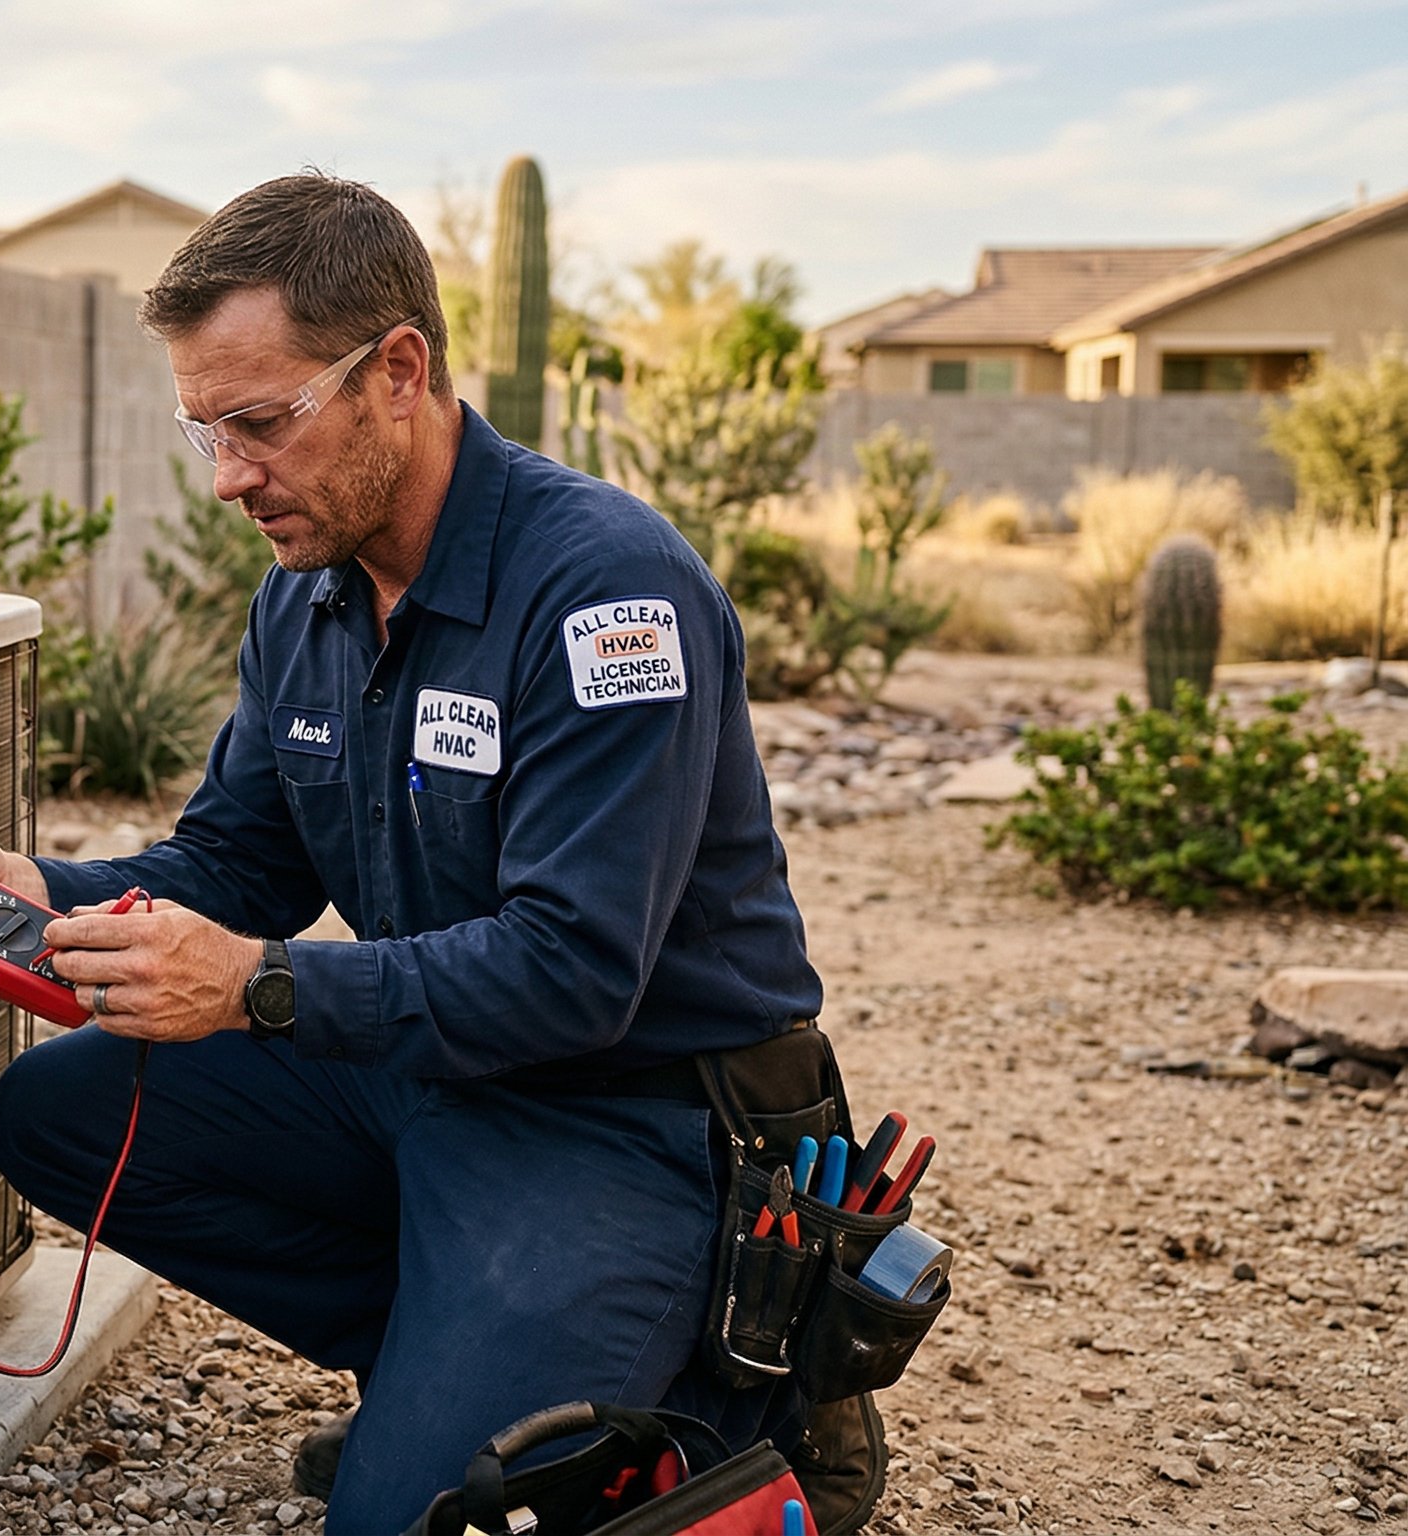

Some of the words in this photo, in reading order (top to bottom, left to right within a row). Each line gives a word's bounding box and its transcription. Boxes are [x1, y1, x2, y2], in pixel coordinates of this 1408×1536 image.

[572, 613, 608, 642] ALL
[613, 606, 673, 632] CLEAR
[601, 633, 655, 654] HVAC
[590, 658, 671, 682] LICENSED
[582, 675, 681, 700] TECHNICIAN
[288, 717, 331, 744] Mark
[420, 703, 443, 727] ALL
[449, 701, 496, 739] CLEAR
[433, 730, 476, 758] HVAC
